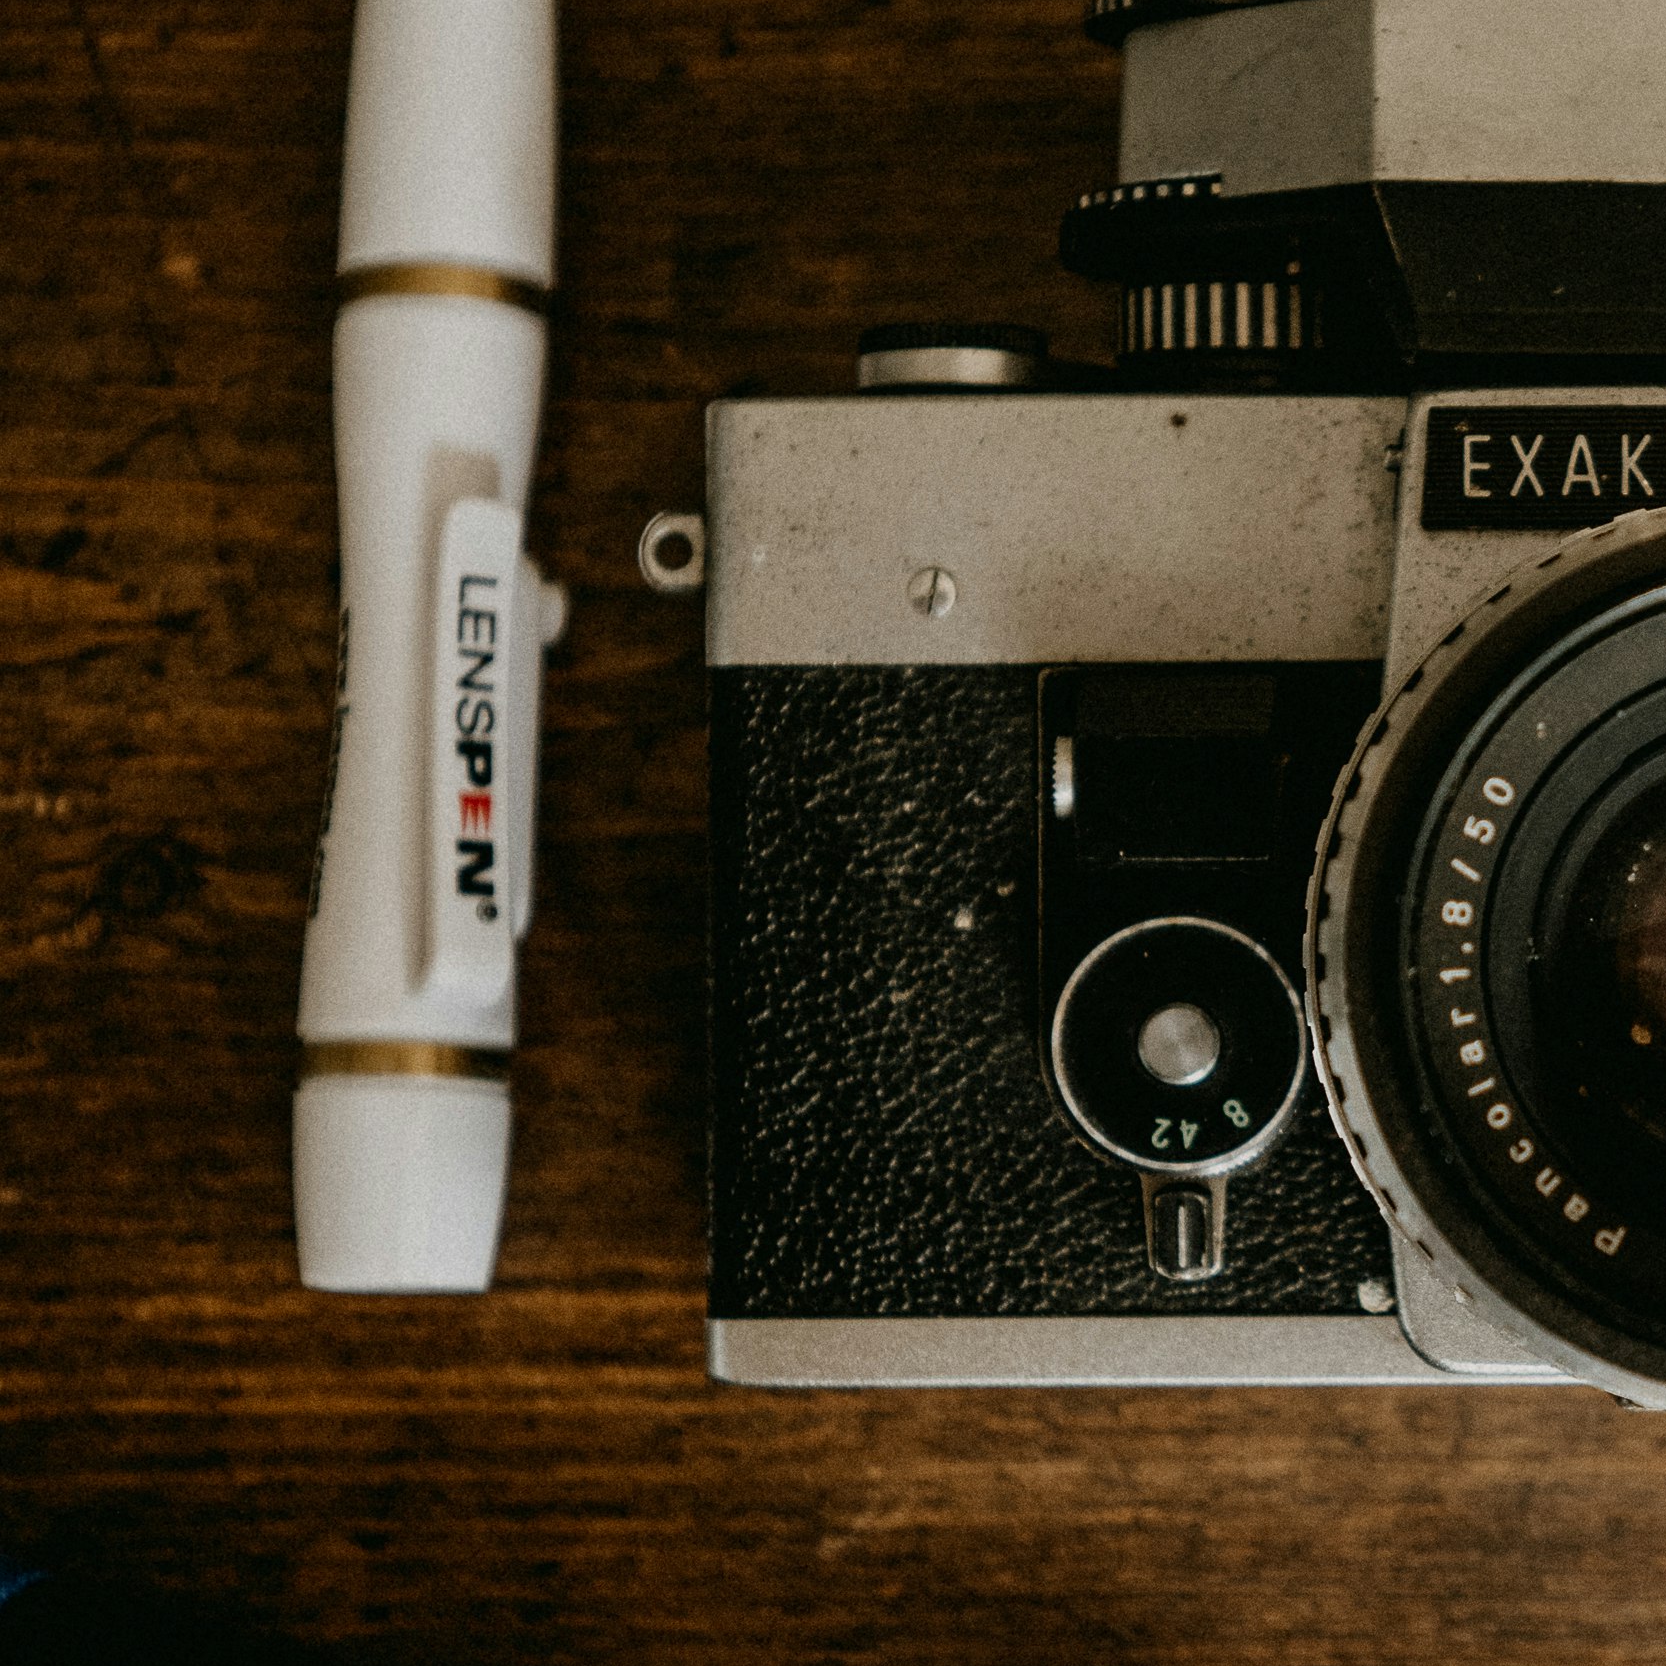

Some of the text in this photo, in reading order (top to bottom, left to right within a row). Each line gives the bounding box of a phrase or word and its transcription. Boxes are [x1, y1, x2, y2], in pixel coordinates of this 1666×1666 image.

[1222, 1099, 1251, 1129] 8
[1439, 774, 1627, 1257] Pancolar 1.8/50
